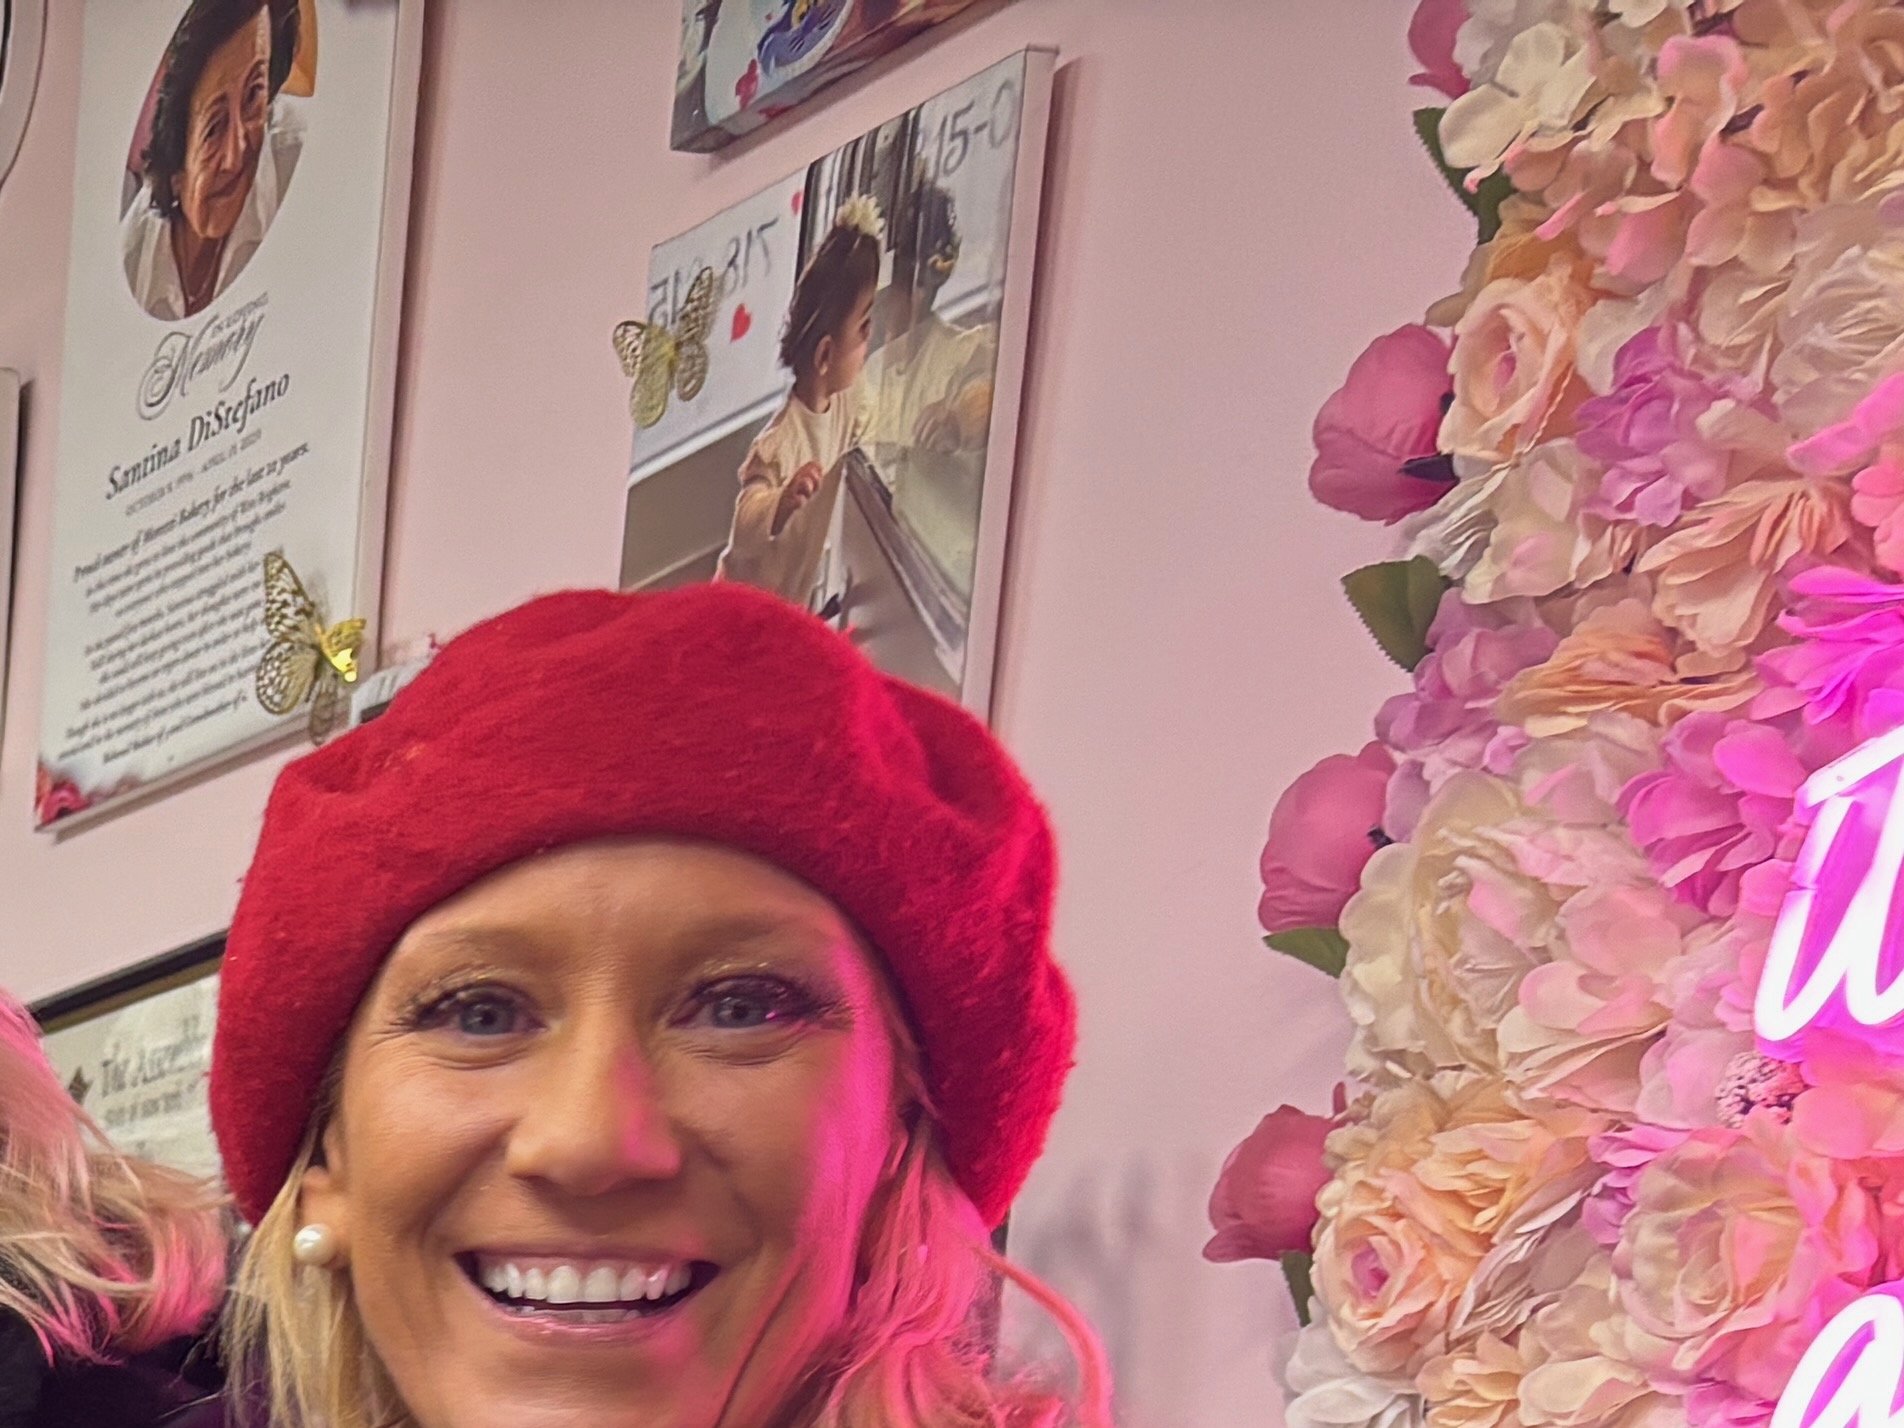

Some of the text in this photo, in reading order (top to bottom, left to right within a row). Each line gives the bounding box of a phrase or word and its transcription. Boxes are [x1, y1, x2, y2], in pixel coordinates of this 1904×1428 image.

[136, 312, 265, 421] Memory
[106, 437, 181, 500] Santina
[188, 373, 290, 454] DiStefano
